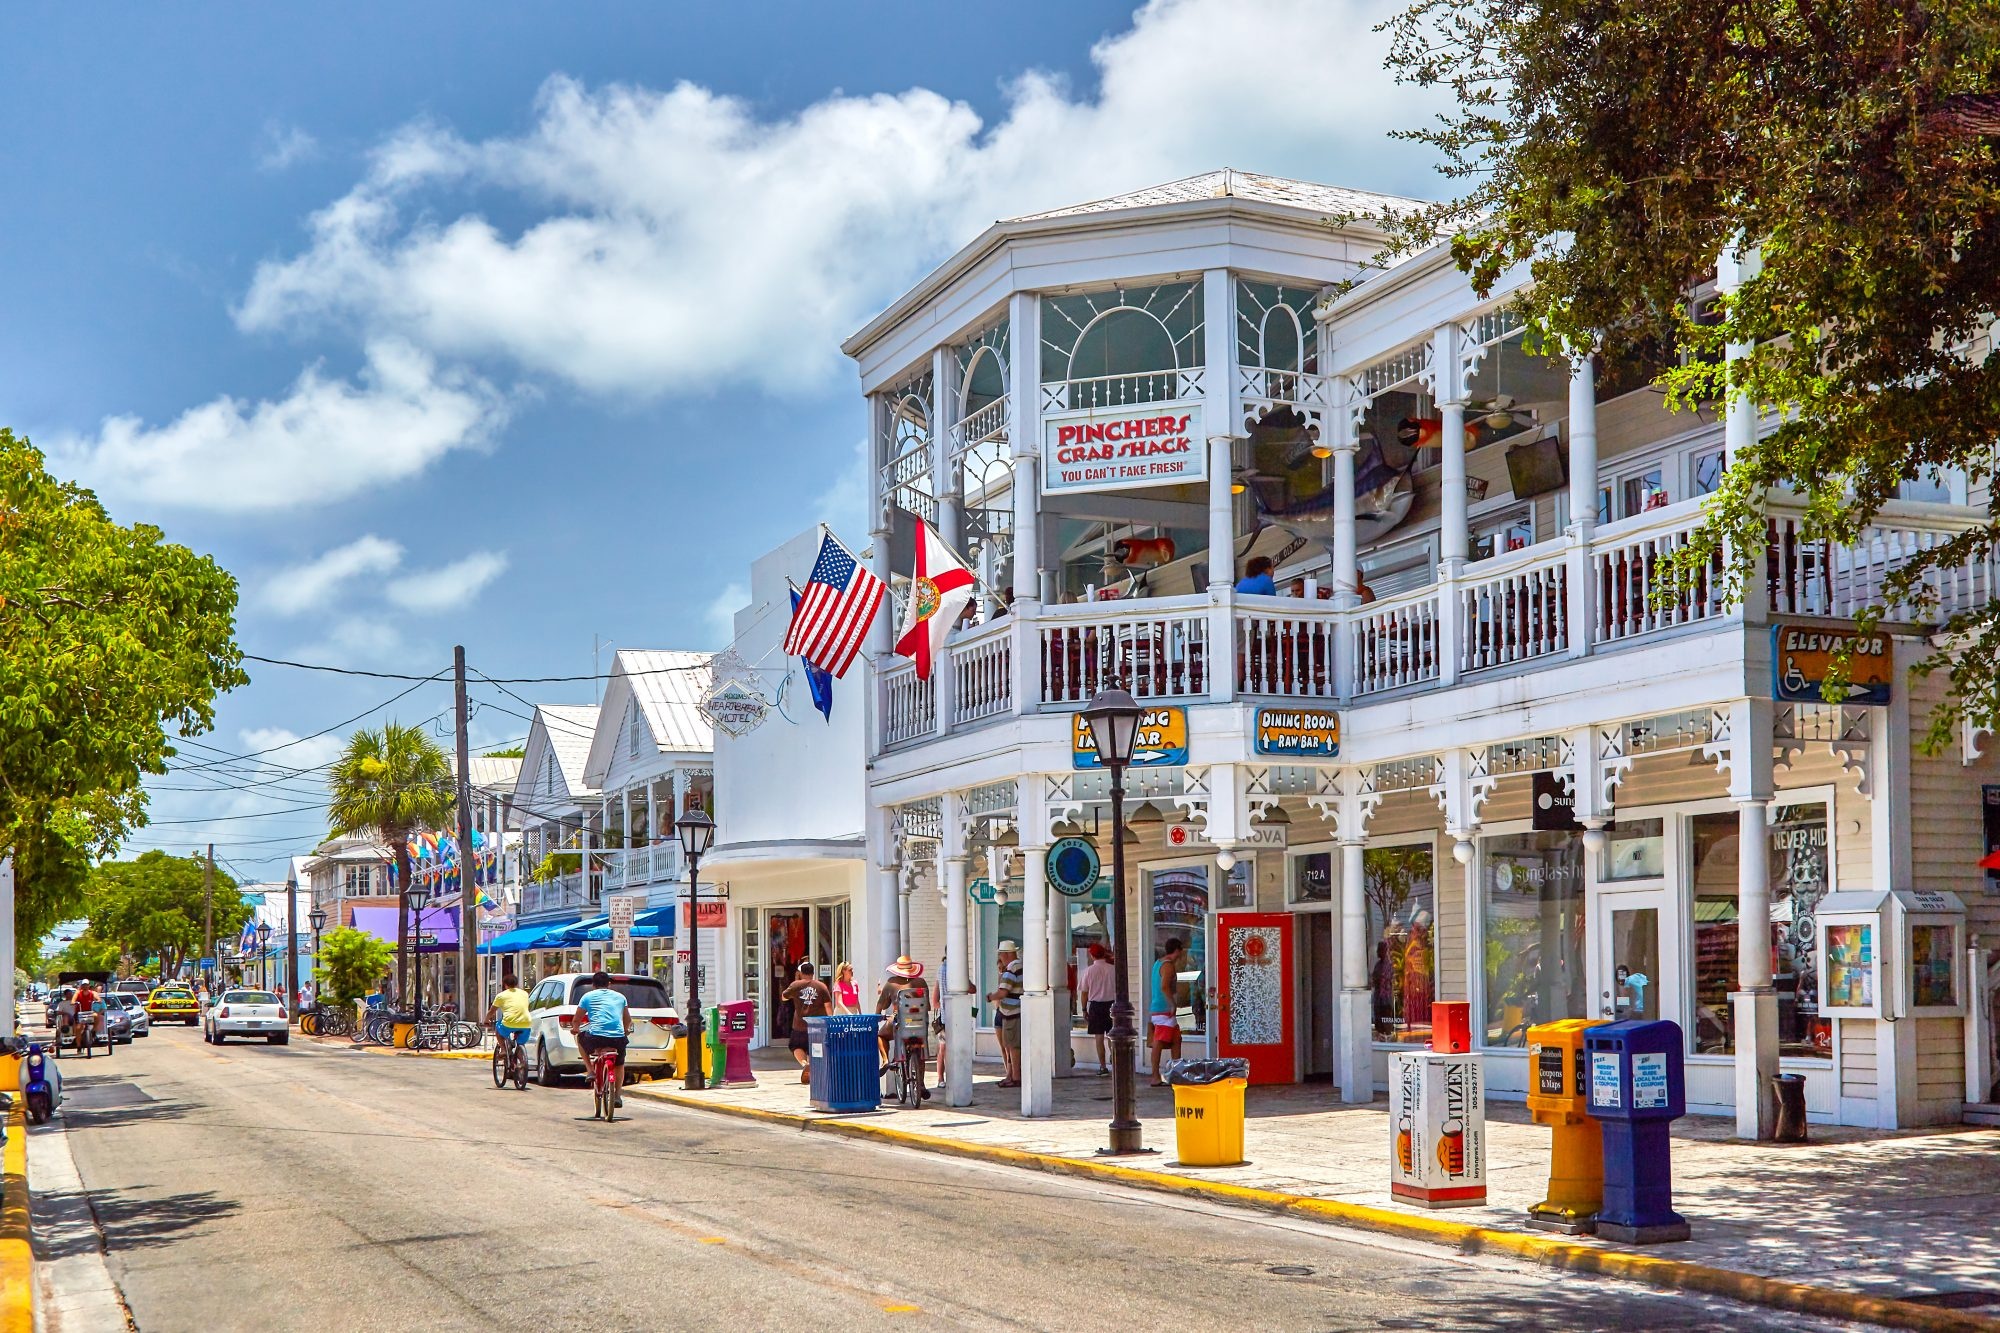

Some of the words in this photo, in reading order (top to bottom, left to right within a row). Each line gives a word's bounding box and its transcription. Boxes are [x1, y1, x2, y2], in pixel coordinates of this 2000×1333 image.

[1057, 414, 1191, 447] PINCHERS
[1057, 443, 1114, 464] CRAB
[1117, 436, 1191, 458] SHACK
[1061, 470, 1082, 482] YOU
[1085, 466, 1117, 480] CAN'T
[1119, 464, 1147, 478] FAKE
[1149, 460, 1184, 474] FRESH
[1261, 712, 1301, 730] DINING
[1303, 714, 1335, 730] ROOM
[1278, 734, 1299, 748] RAW
[1301, 735, 1319, 748] BAR
[1773, 831, 1808, 851] NEVER
[1307, 870, 1319, 880] 712
[1516, 861, 1569, 886] sunglass
[1540, 1069, 1562, 1079] Coupons
[1541, 1080, 1547, 1088] &
[1547, 1080, 1561, 1090] Maps
[1398, 1062, 1412, 1137] CITIZEN
[1441, 1063, 1464, 1138] CITIZEN
[1402, 1144, 1413, 1178] THE
[1449, 1145, 1464, 1181] THE
